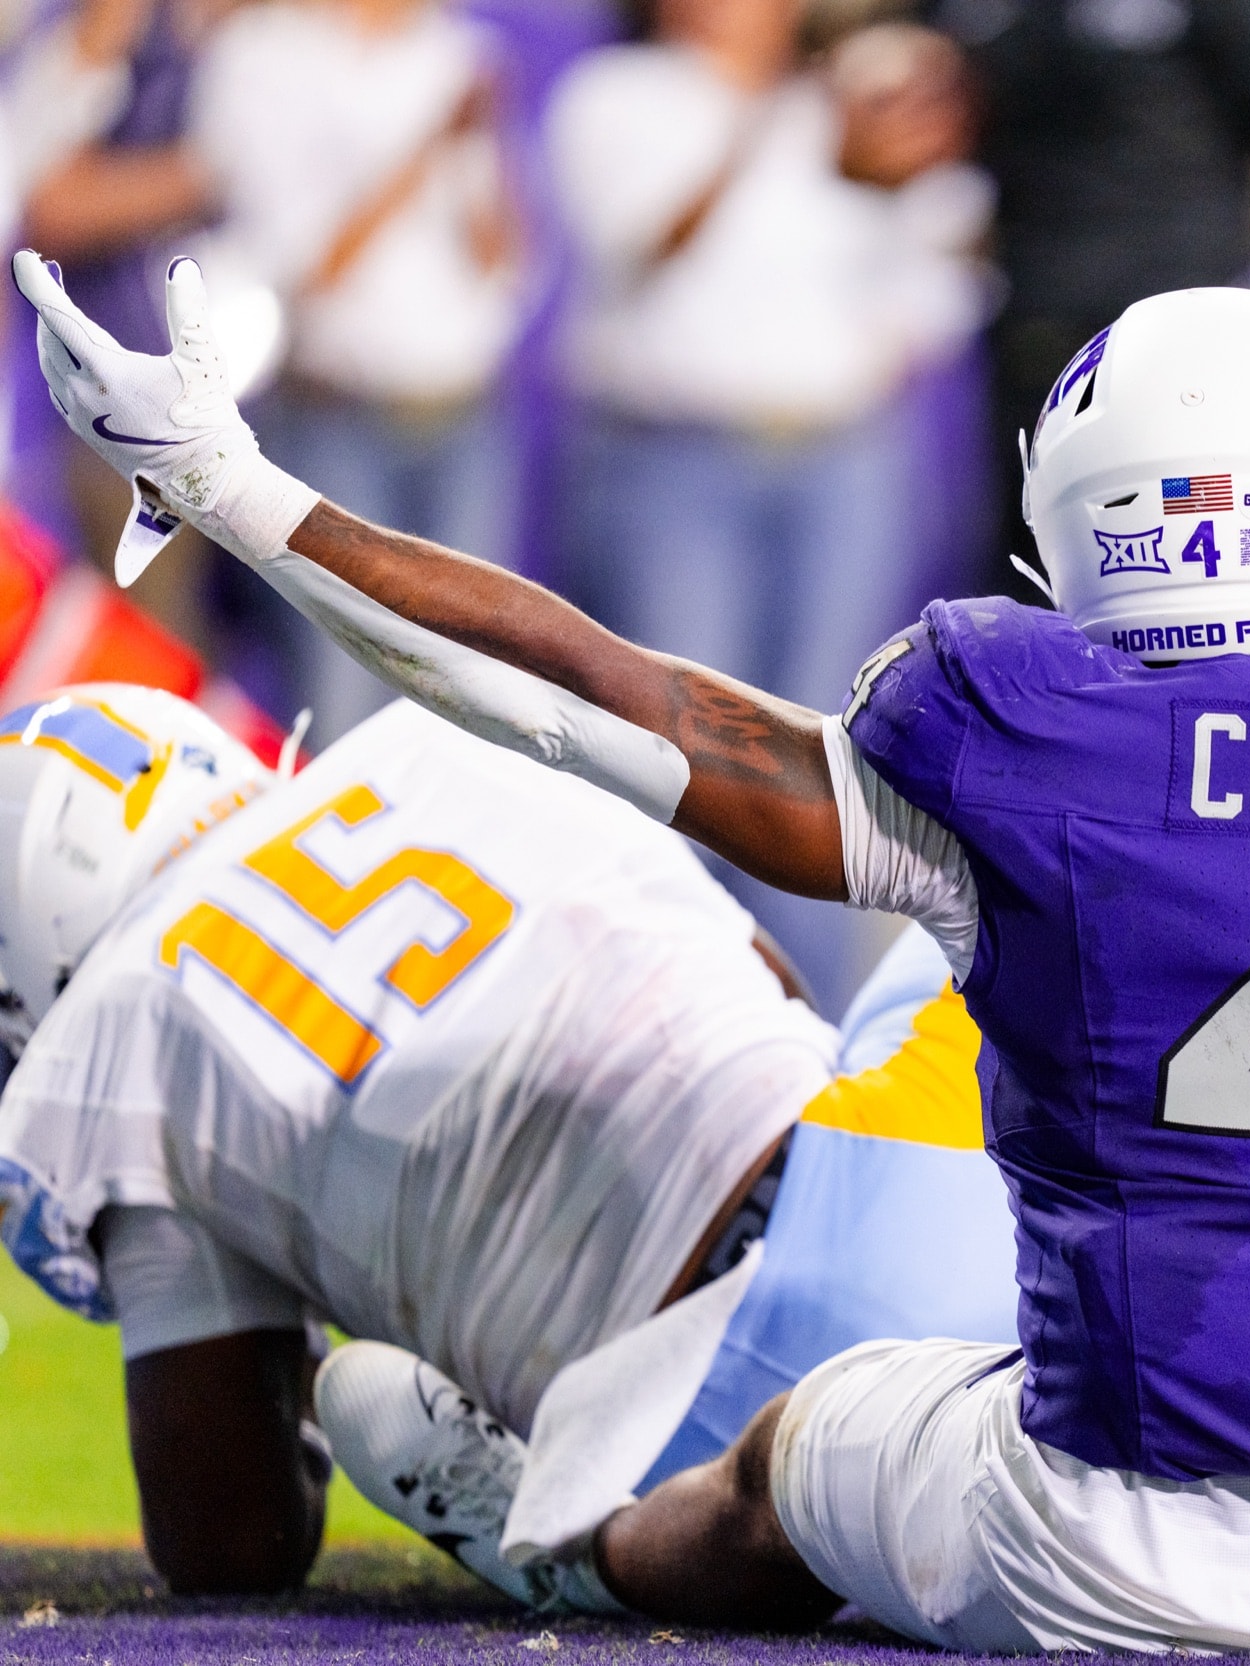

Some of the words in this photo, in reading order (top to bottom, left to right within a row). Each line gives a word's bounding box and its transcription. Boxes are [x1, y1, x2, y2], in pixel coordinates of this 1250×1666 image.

[1097, 530, 1169, 574] XII
[1181, 520, 1221, 578] 4
[1111, 623, 1227, 654] HORNED
[160, 782, 517, 1089] 15
